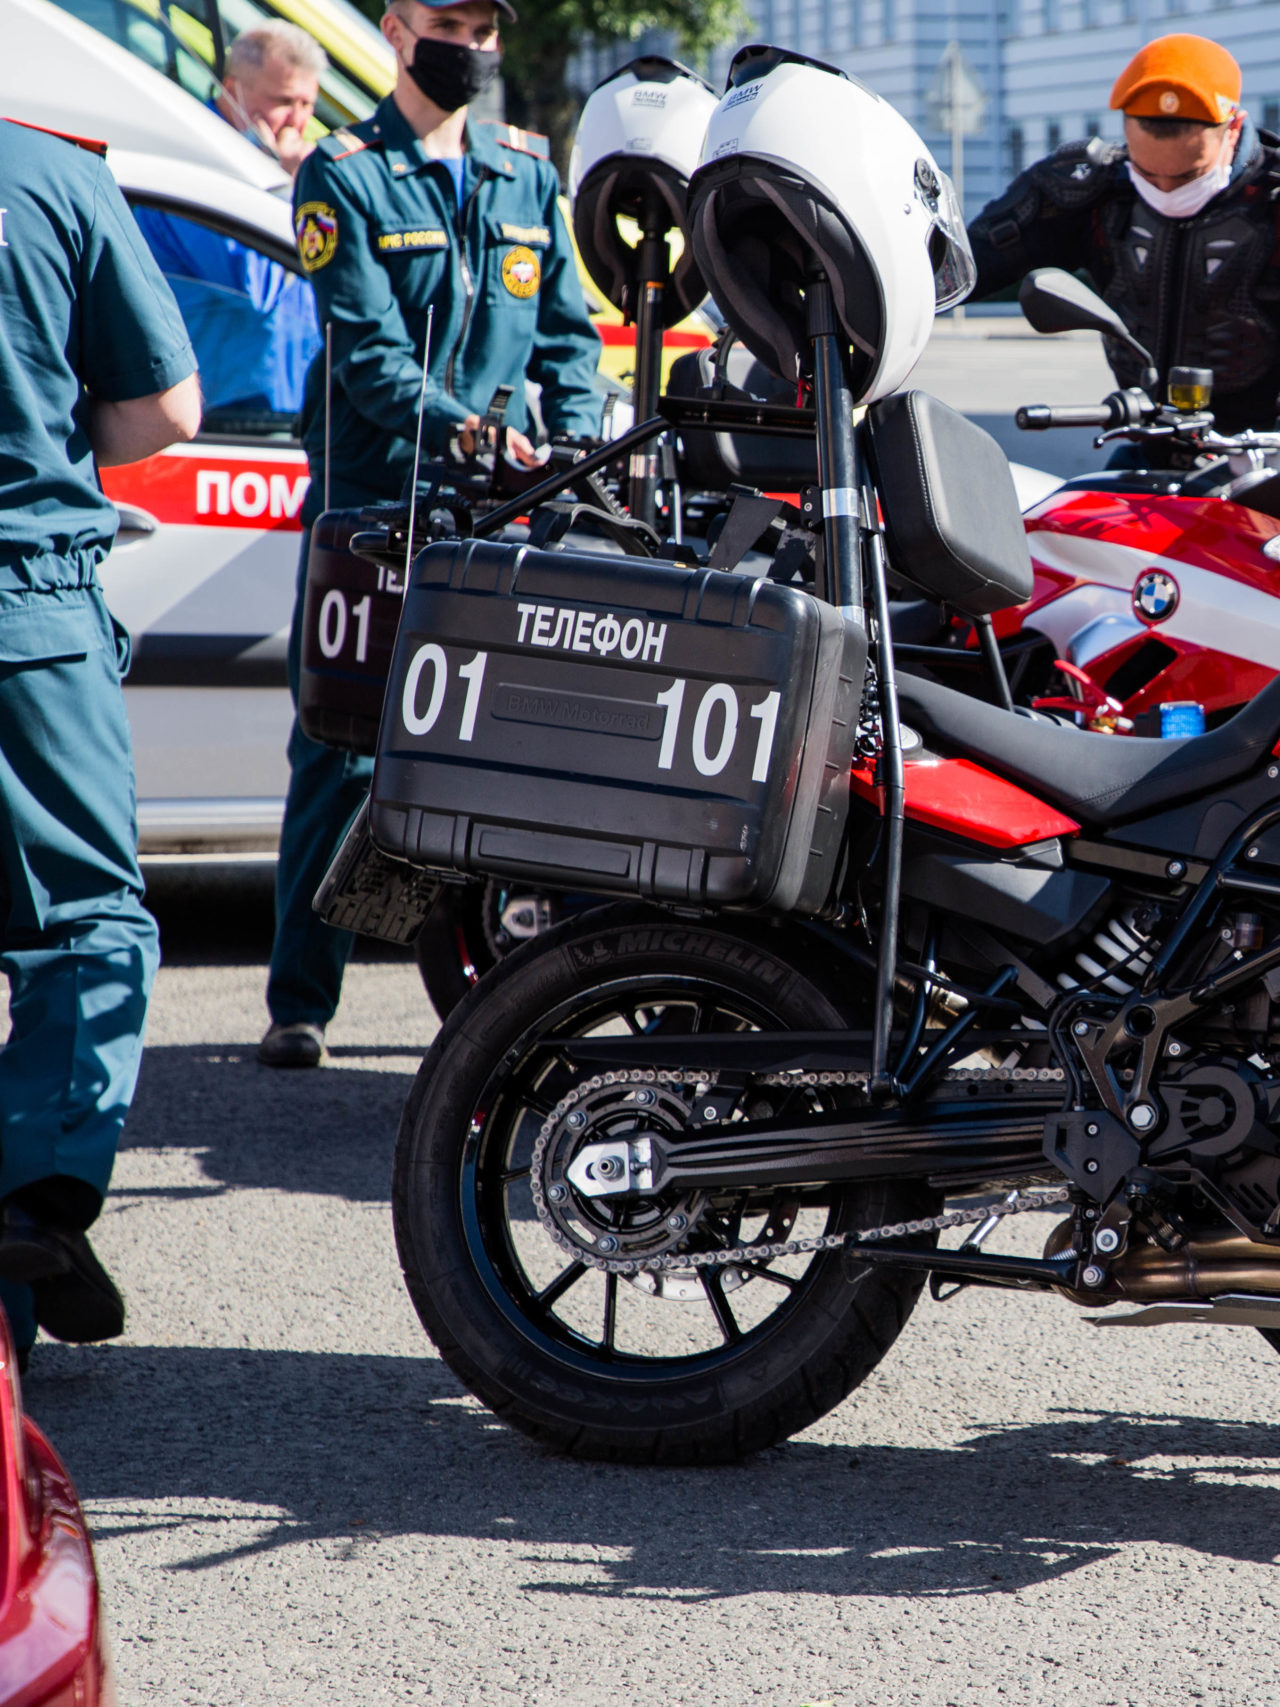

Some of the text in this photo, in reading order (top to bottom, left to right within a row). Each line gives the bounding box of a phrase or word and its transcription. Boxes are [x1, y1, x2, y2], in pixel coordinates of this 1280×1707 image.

[197, 470, 311, 518] ПОМ
[318, 589, 371, 663] 01
[517, 603, 667, 663] ТЕЛЕФОН
[402, 643, 781, 783] 01 101
[507, 694, 650, 730] BMW Motorrad
[617, 931, 785, 984] MICHELIN
